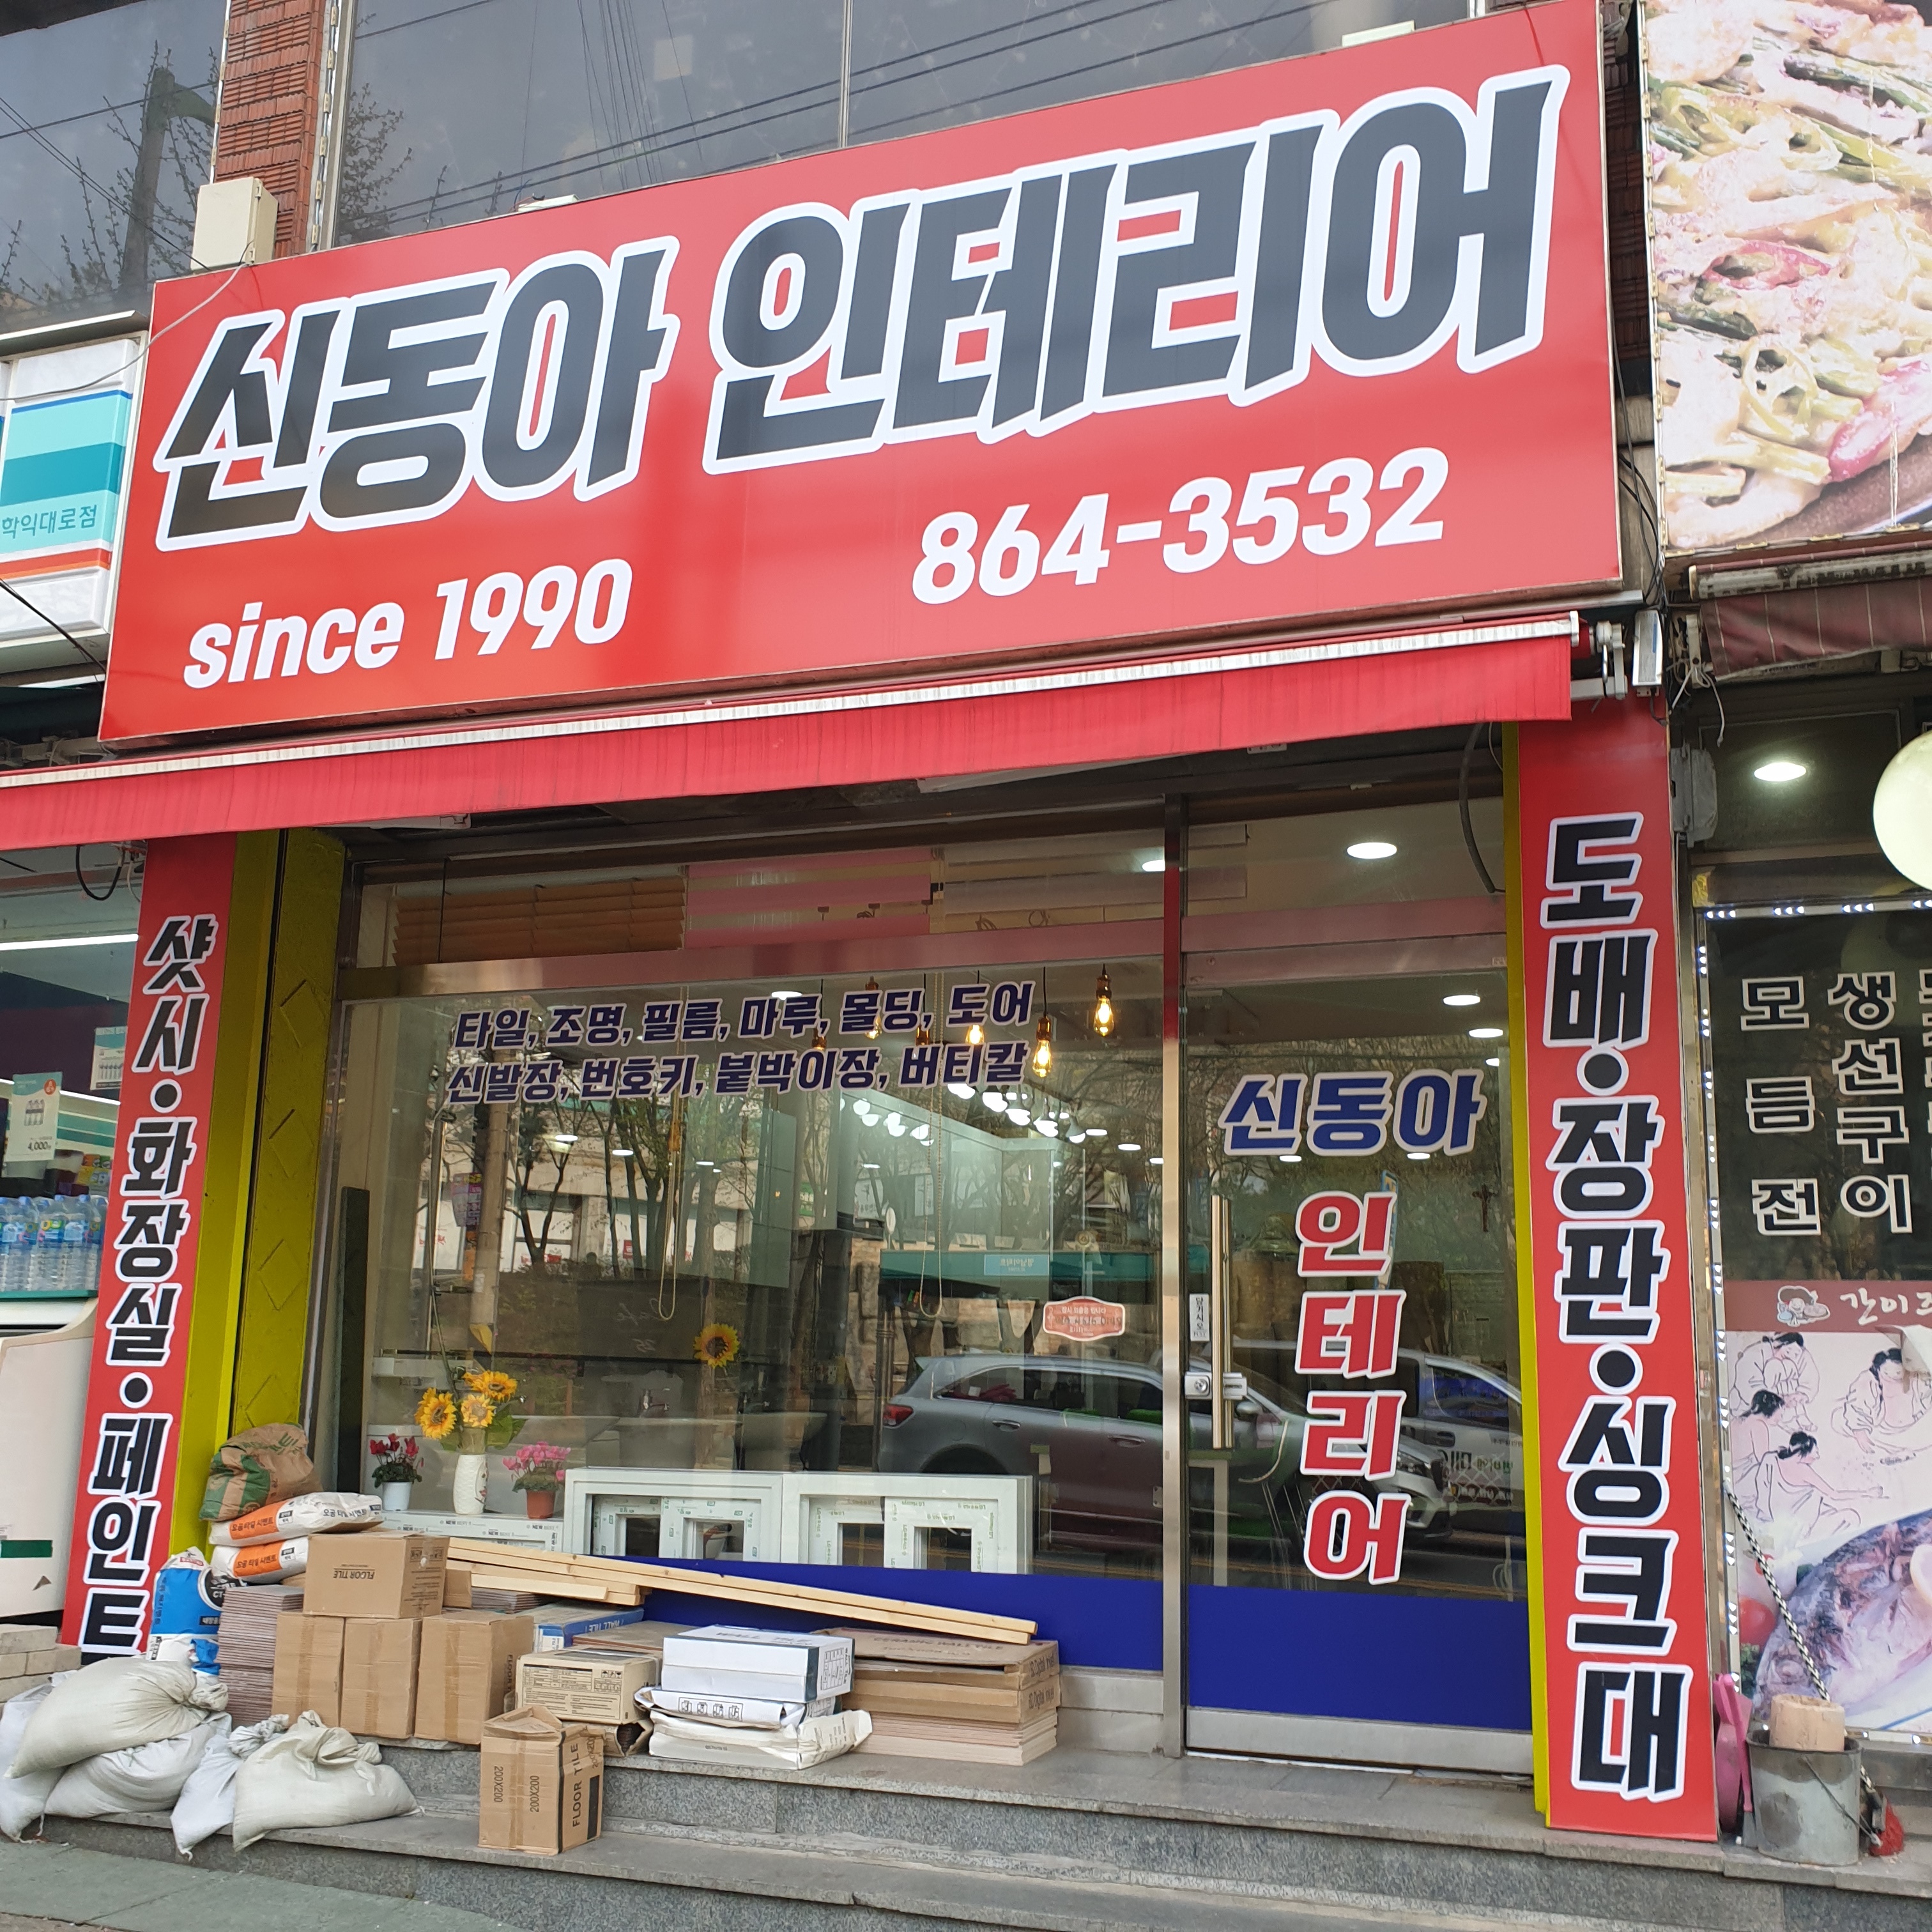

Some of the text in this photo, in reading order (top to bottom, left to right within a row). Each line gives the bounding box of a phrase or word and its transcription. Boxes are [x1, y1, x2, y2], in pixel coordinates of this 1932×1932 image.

[153, 65, 1570, 552] 신동아 인테리어
[2, 504, 97, 539] 학익대로점
[912, 446, 1448, 604] 864-3532
[183, 558, 632, 689] since 1990
[947, 981, 1035, 1026] 도어
[900, 1041, 1031, 1088] 버티칼
[1217, 1068, 1487, 1156] 신동아
[1295, 1191, 1411, 1584] 인테리어
[333, 1570, 376, 1580] FLOOR TILE
[570, 1743, 583, 1827] FLOOR TILE
